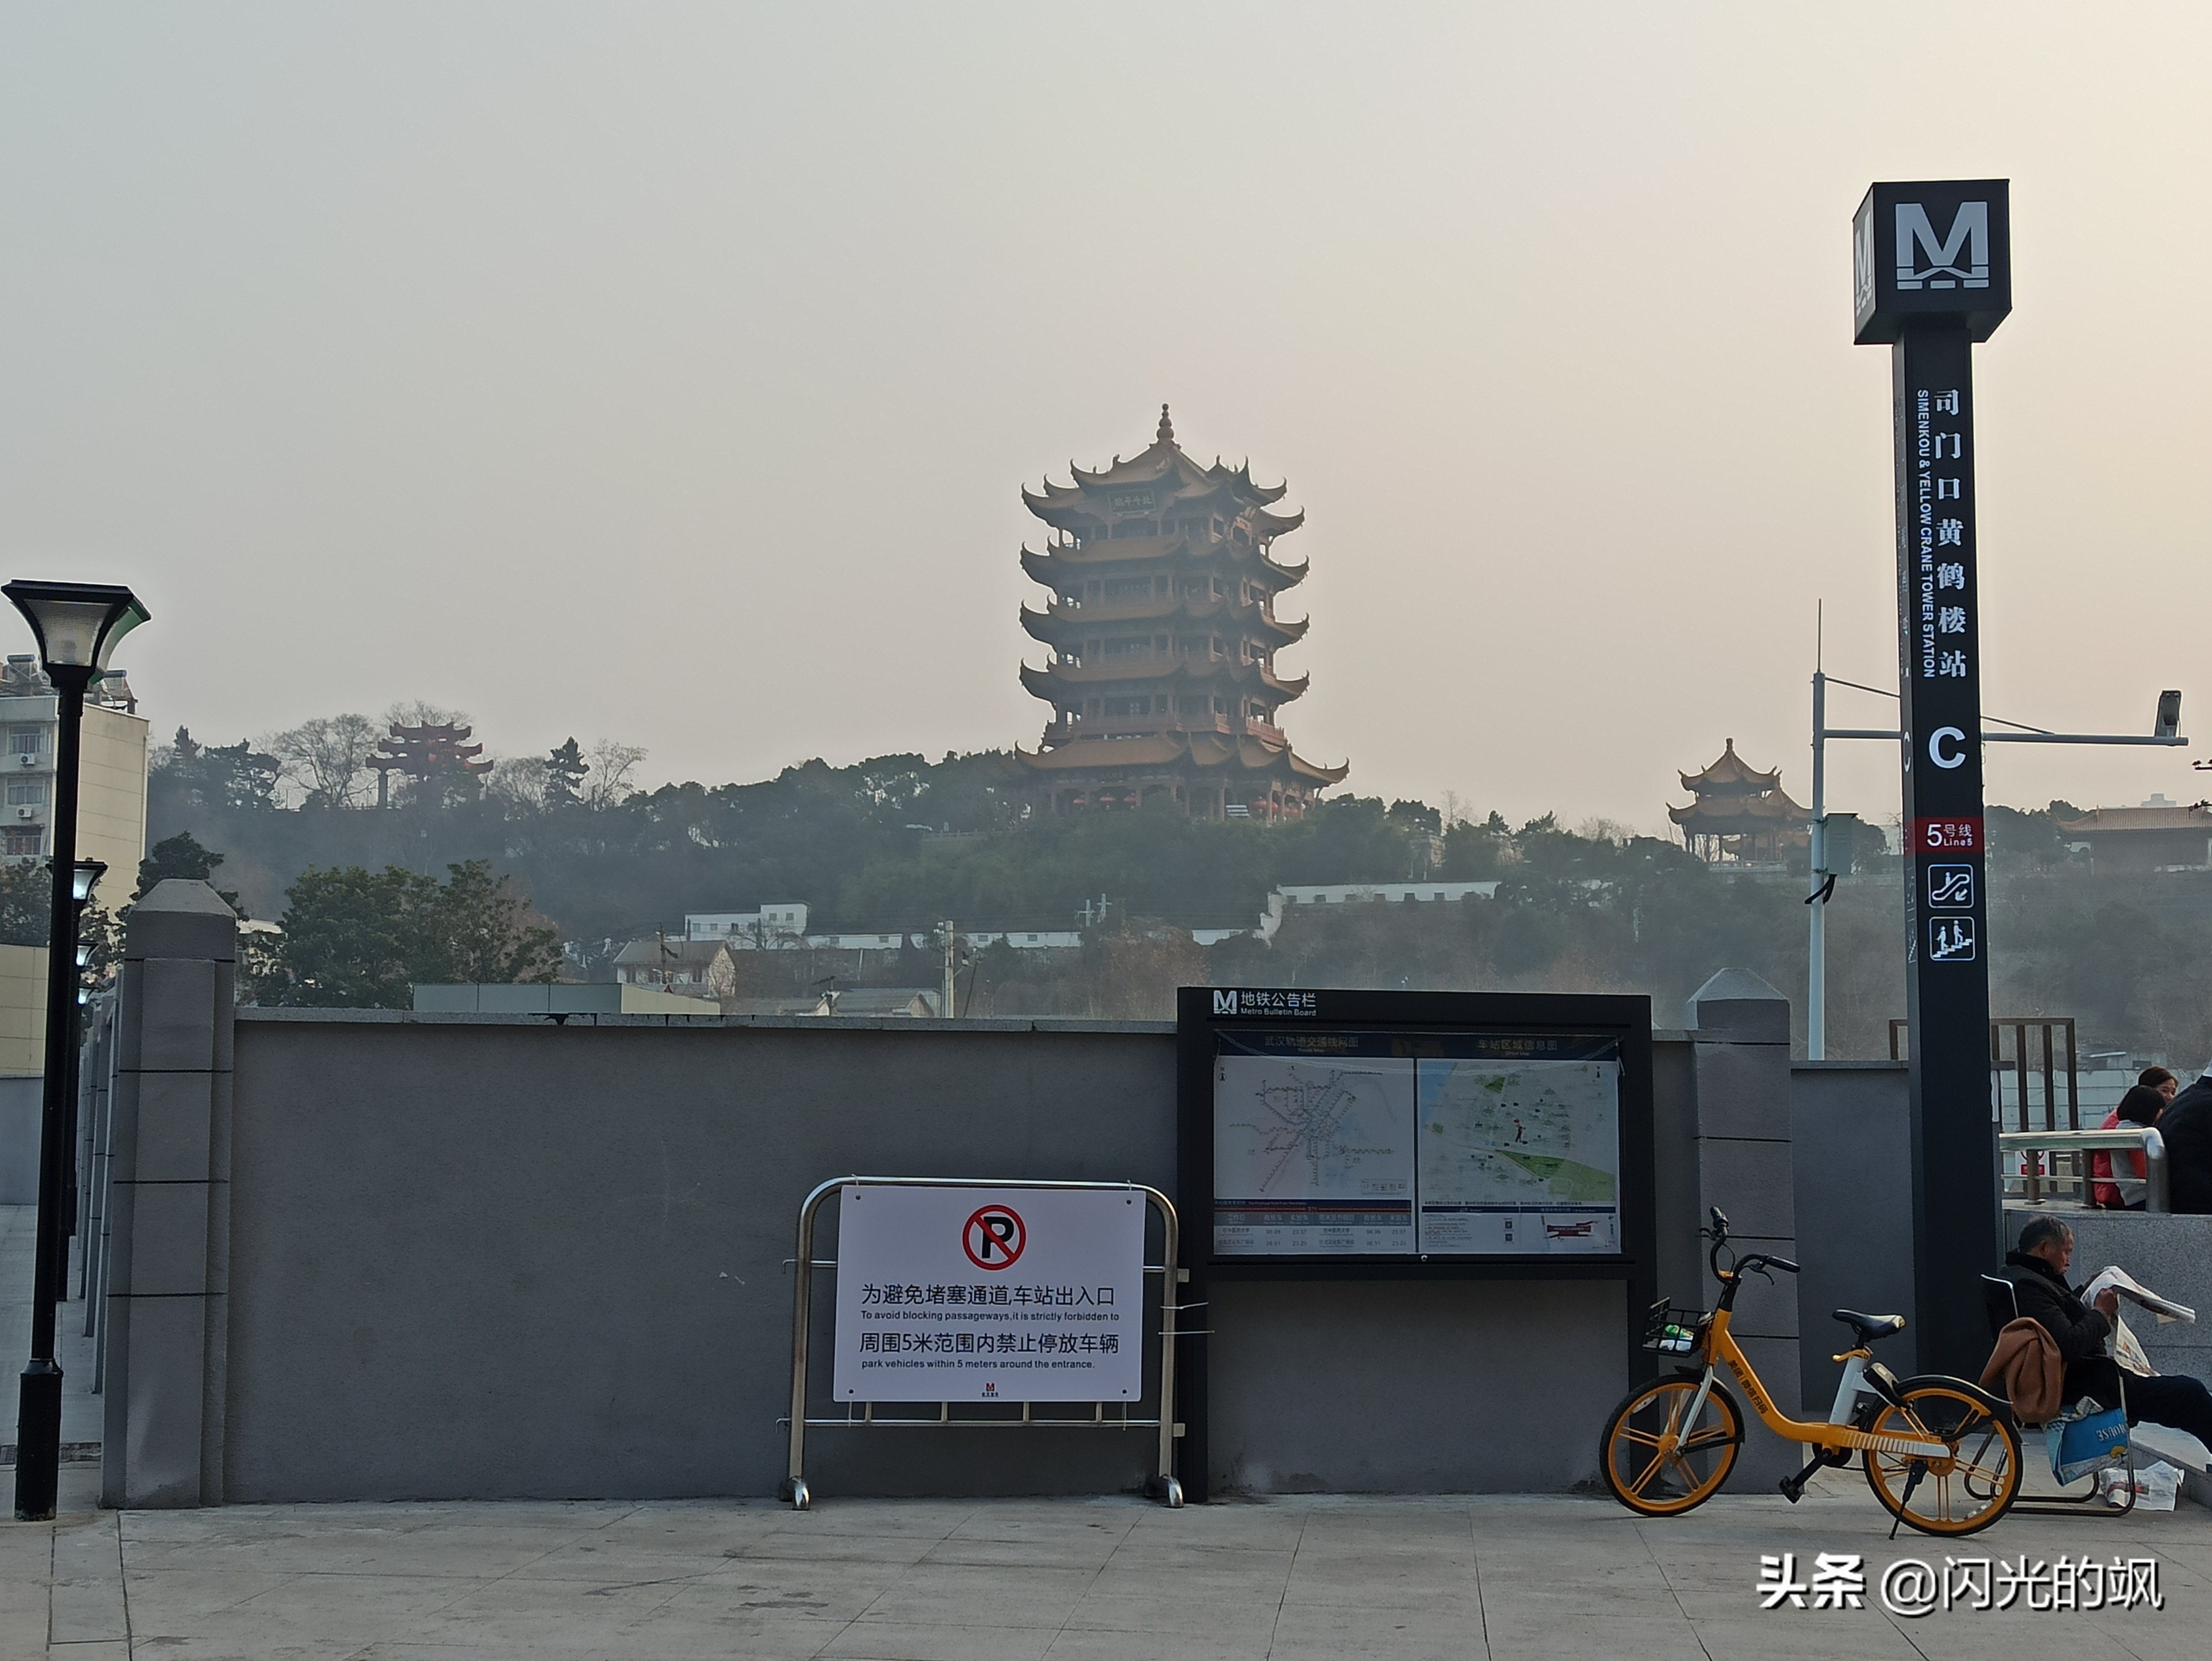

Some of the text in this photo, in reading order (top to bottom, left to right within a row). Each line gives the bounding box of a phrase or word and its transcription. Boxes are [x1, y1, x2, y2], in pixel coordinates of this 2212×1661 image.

[1895, 201, 1989, 290] M
[1917, 389, 1935, 678] SIMENKOU & YELLOW CRANE TOWER STATION
[1934, 389, 1967, 678] 司门口黄鹤楼站
[1929, 726, 1966, 769] C
[1927, 824, 1973, 847] 5号线
[1241, 991, 1316, 1007] 地铁公告栏
[861, 1310, 873, 1319] To
[874, 1311, 900, 1319] avoid
[903, 1311, 943, 1322] blocking
[1020, 1312, 1029, 1320] is
[1030, 1312, 1062, 1322] strictly
[1064, 1312, 1108, 1321] forbidden
[1110, 1313, 1119, 1321] to
[860, 1332, 1119, 1354] 周围5米范围内禁止停放车辆
[862, 1359, 1095, 1370] park vehicles within 5 meters around the entrance.
